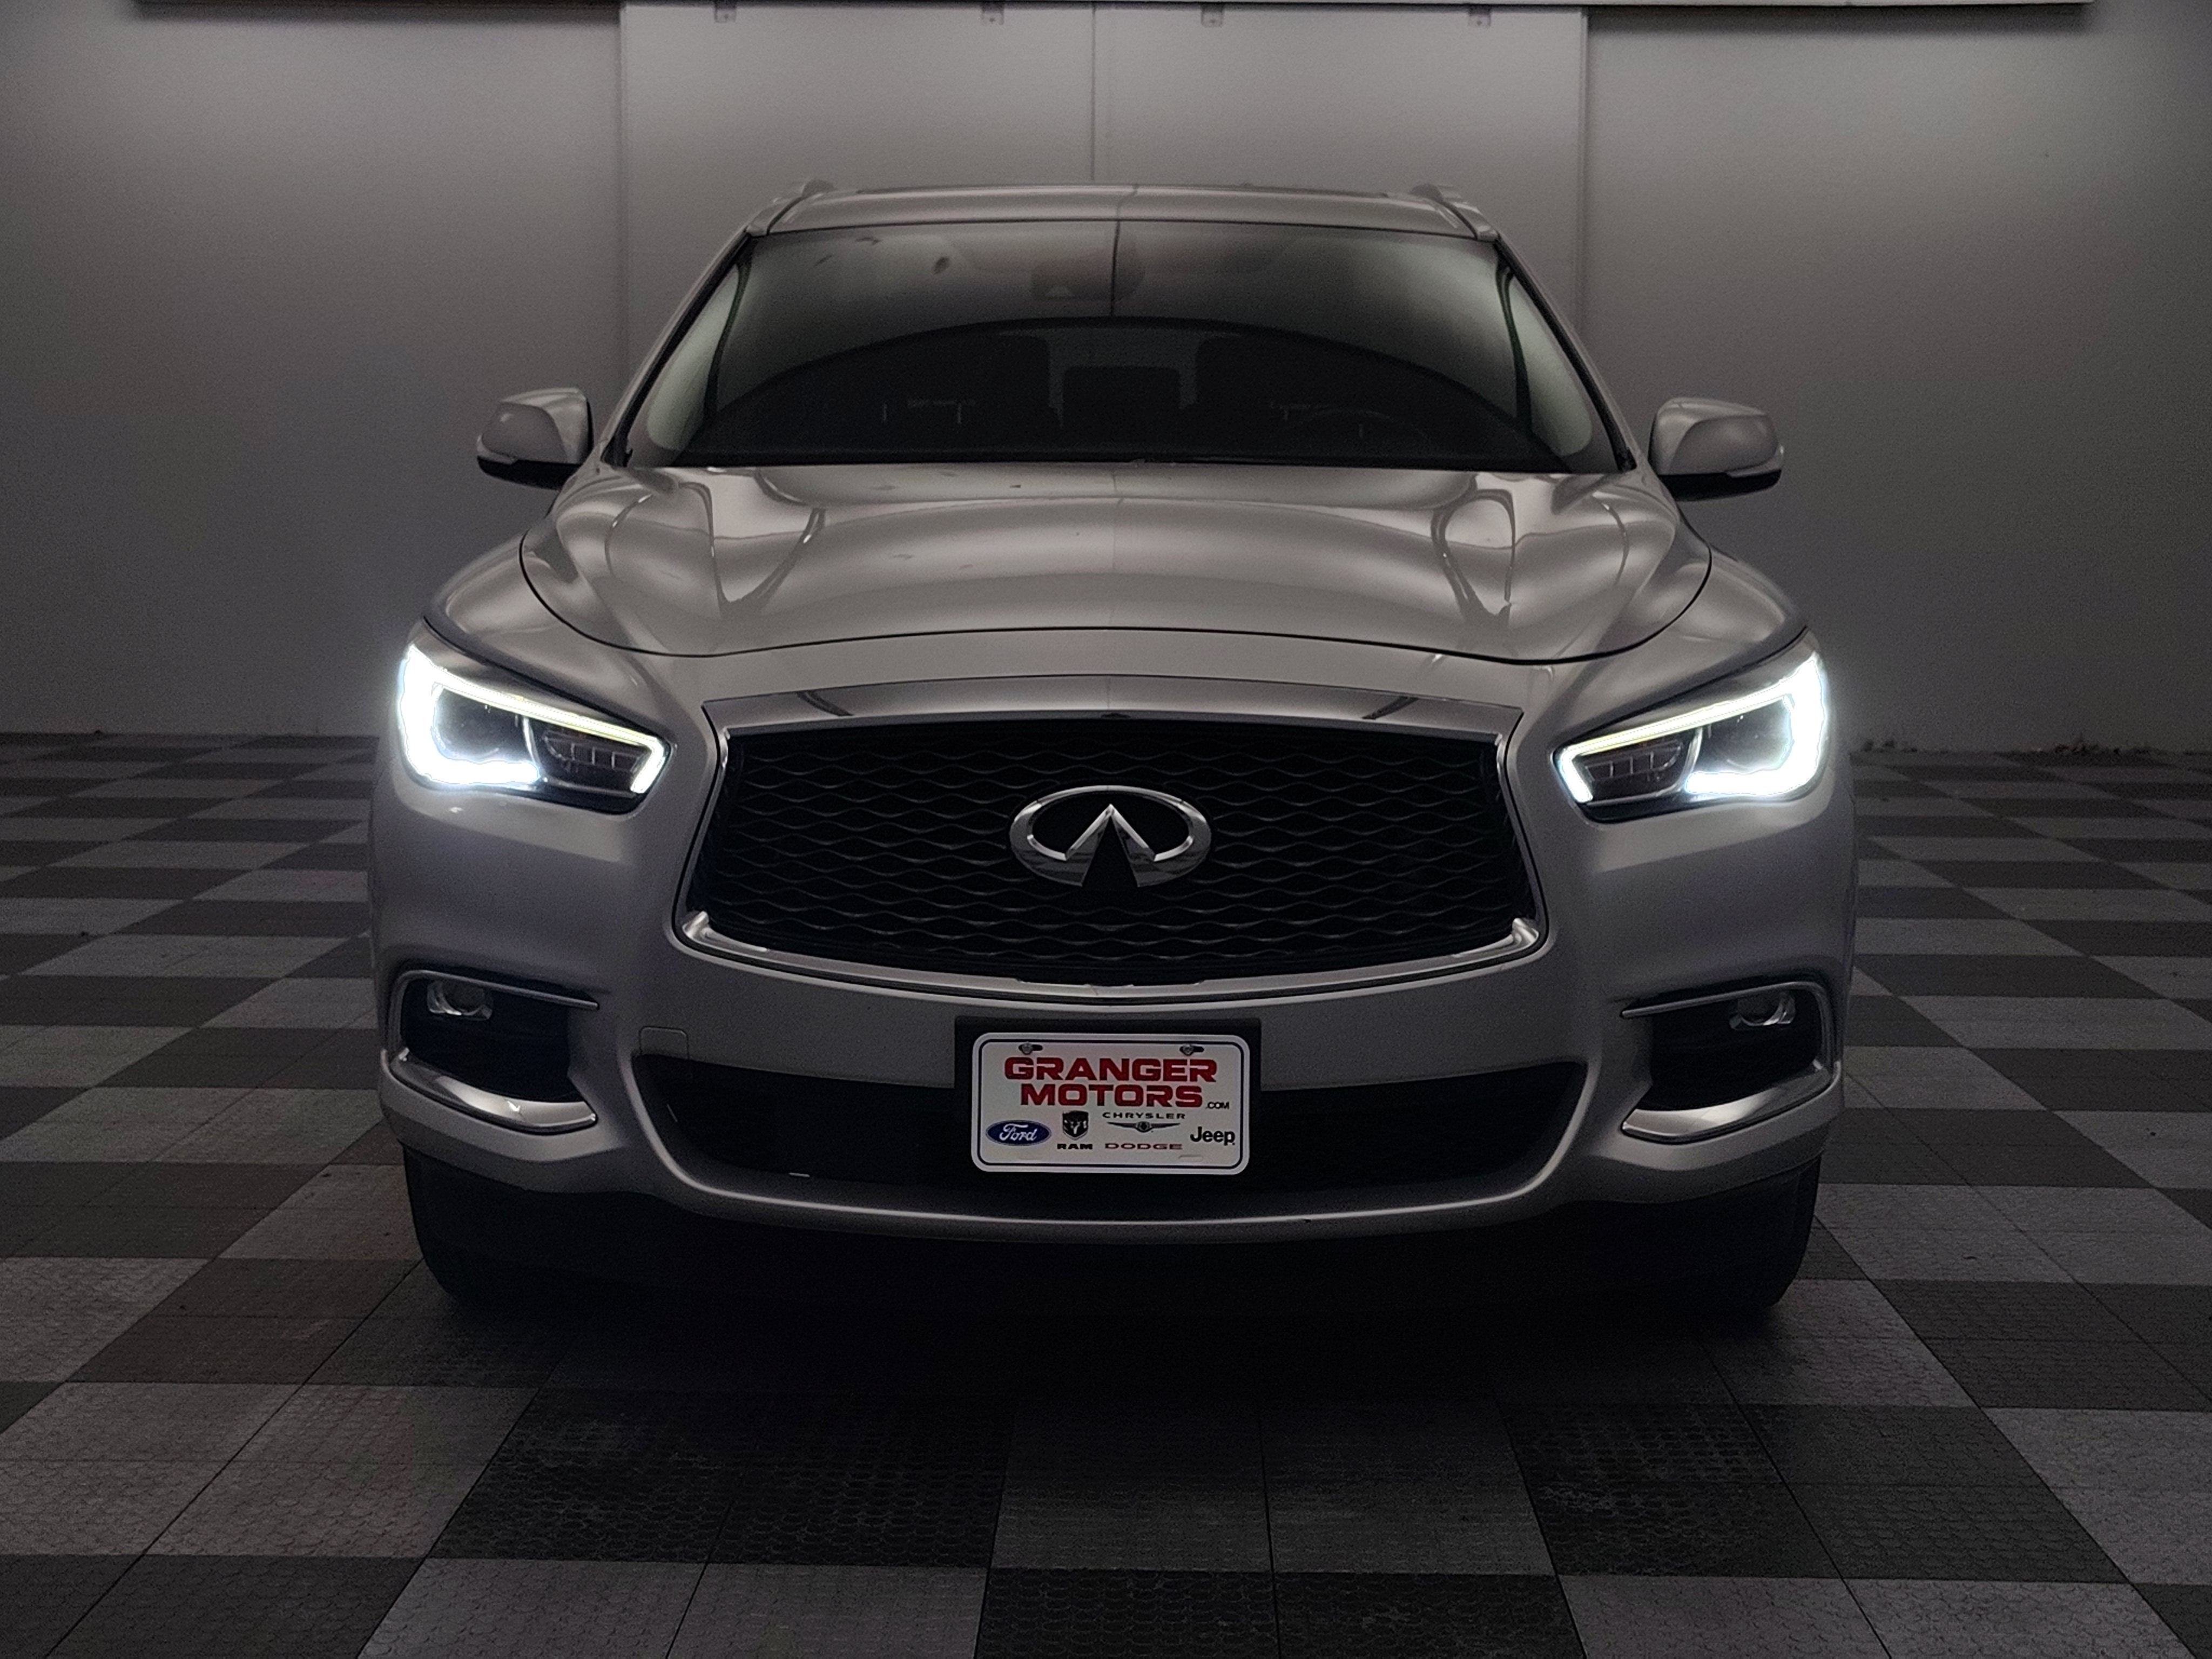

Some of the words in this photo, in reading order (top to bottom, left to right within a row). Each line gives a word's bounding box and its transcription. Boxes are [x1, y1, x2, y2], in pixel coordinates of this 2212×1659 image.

[1004, 1057, 1217, 1082] GRANGER
[1021, 1084, 1203, 1108] MOTORS
[999, 1124, 1037, 1142] Ford
[1190, 1127, 1235, 1145] Jeep
